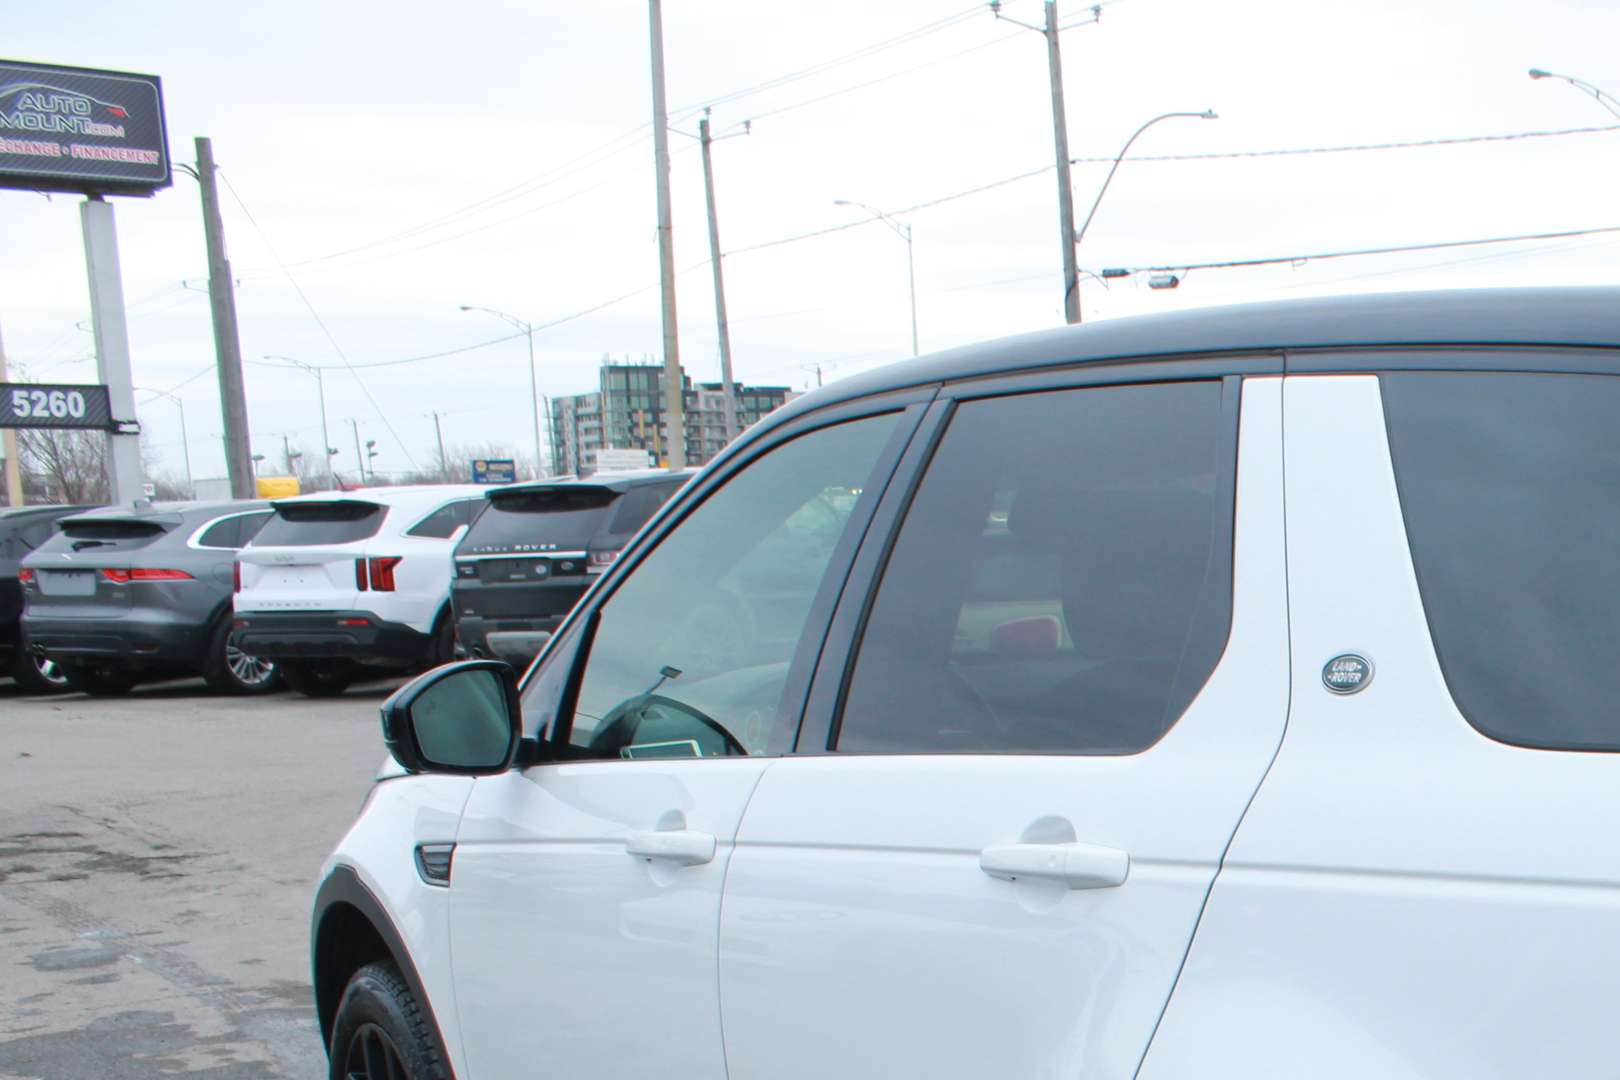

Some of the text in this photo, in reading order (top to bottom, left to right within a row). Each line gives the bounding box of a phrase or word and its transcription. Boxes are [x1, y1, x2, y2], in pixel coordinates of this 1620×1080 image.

[17, 92, 92, 115] AUTO
[12, 390, 86, 418] 5260
[514, 543, 557, 551] ROVER
